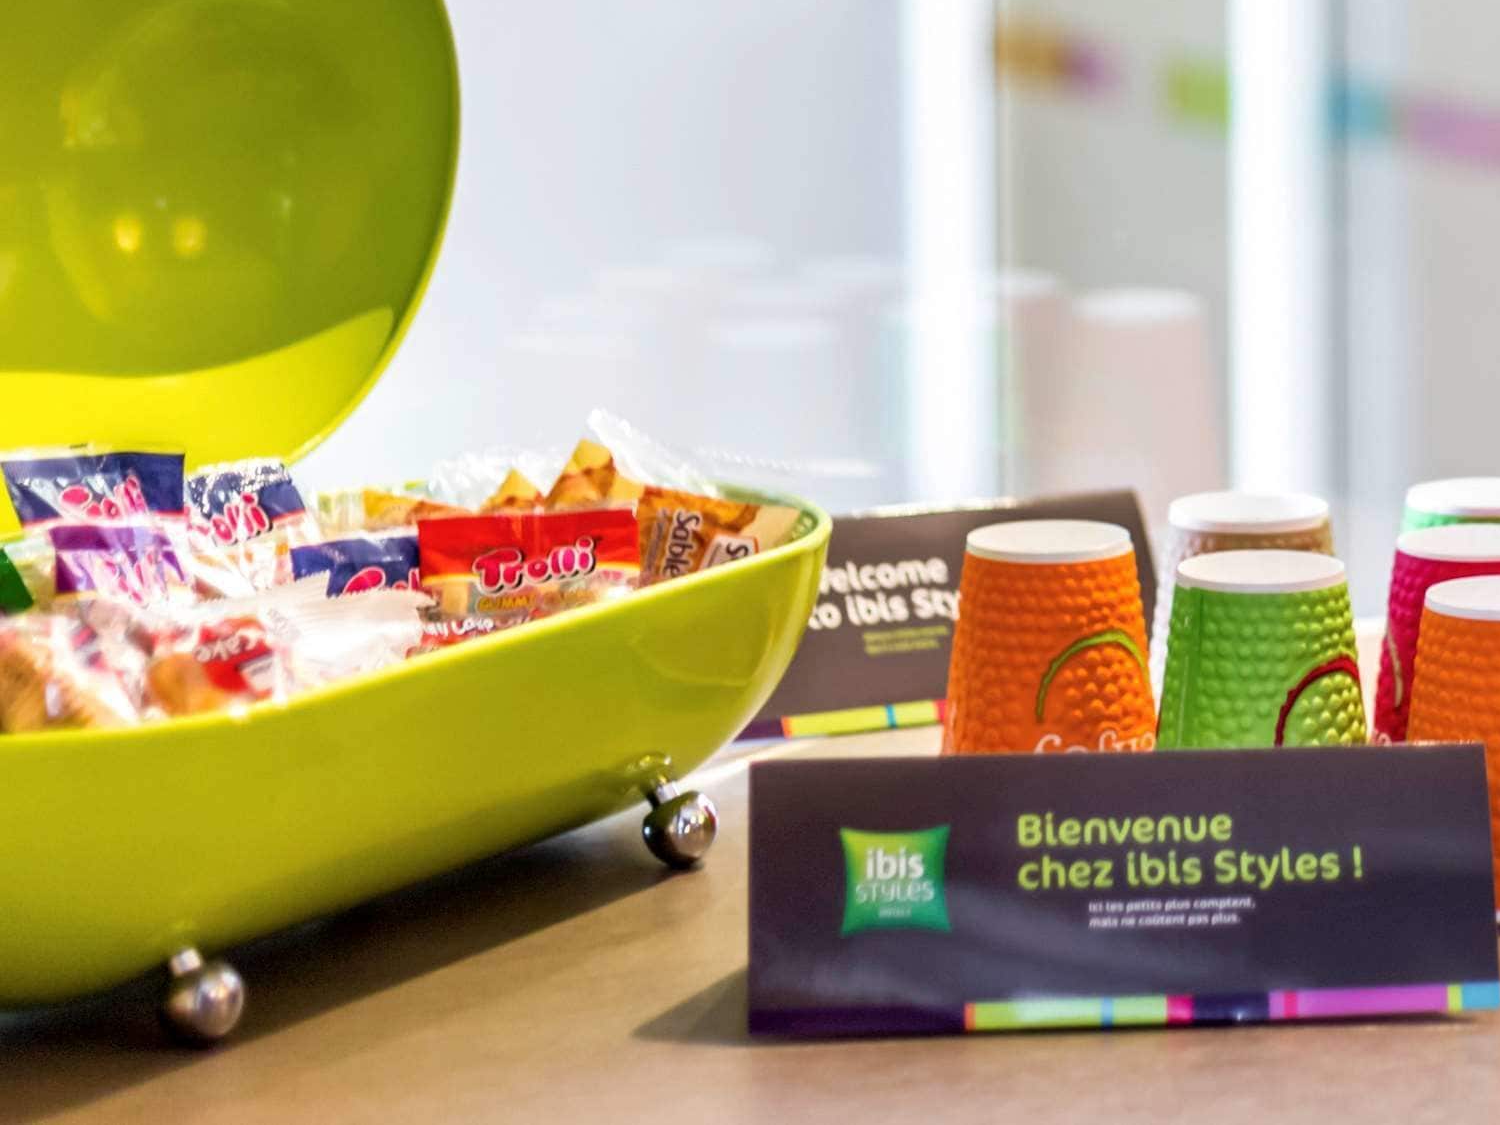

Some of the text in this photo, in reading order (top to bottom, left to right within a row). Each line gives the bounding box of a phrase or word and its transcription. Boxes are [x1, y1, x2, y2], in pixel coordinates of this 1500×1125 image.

[472, 536, 597, 595] Trolli
[1016, 812, 1232, 848] Bienvenue
[866, 847, 924, 880] ibis
[1017, 852, 1113, 890] chez
[1126, 849, 1203, 887] ibis
[1212, 845, 1341, 890] Styles
[855, 879, 935, 905] STYLES
[1126, 899, 1162, 914] petits
[1164, 897, 1191, 912] plus
